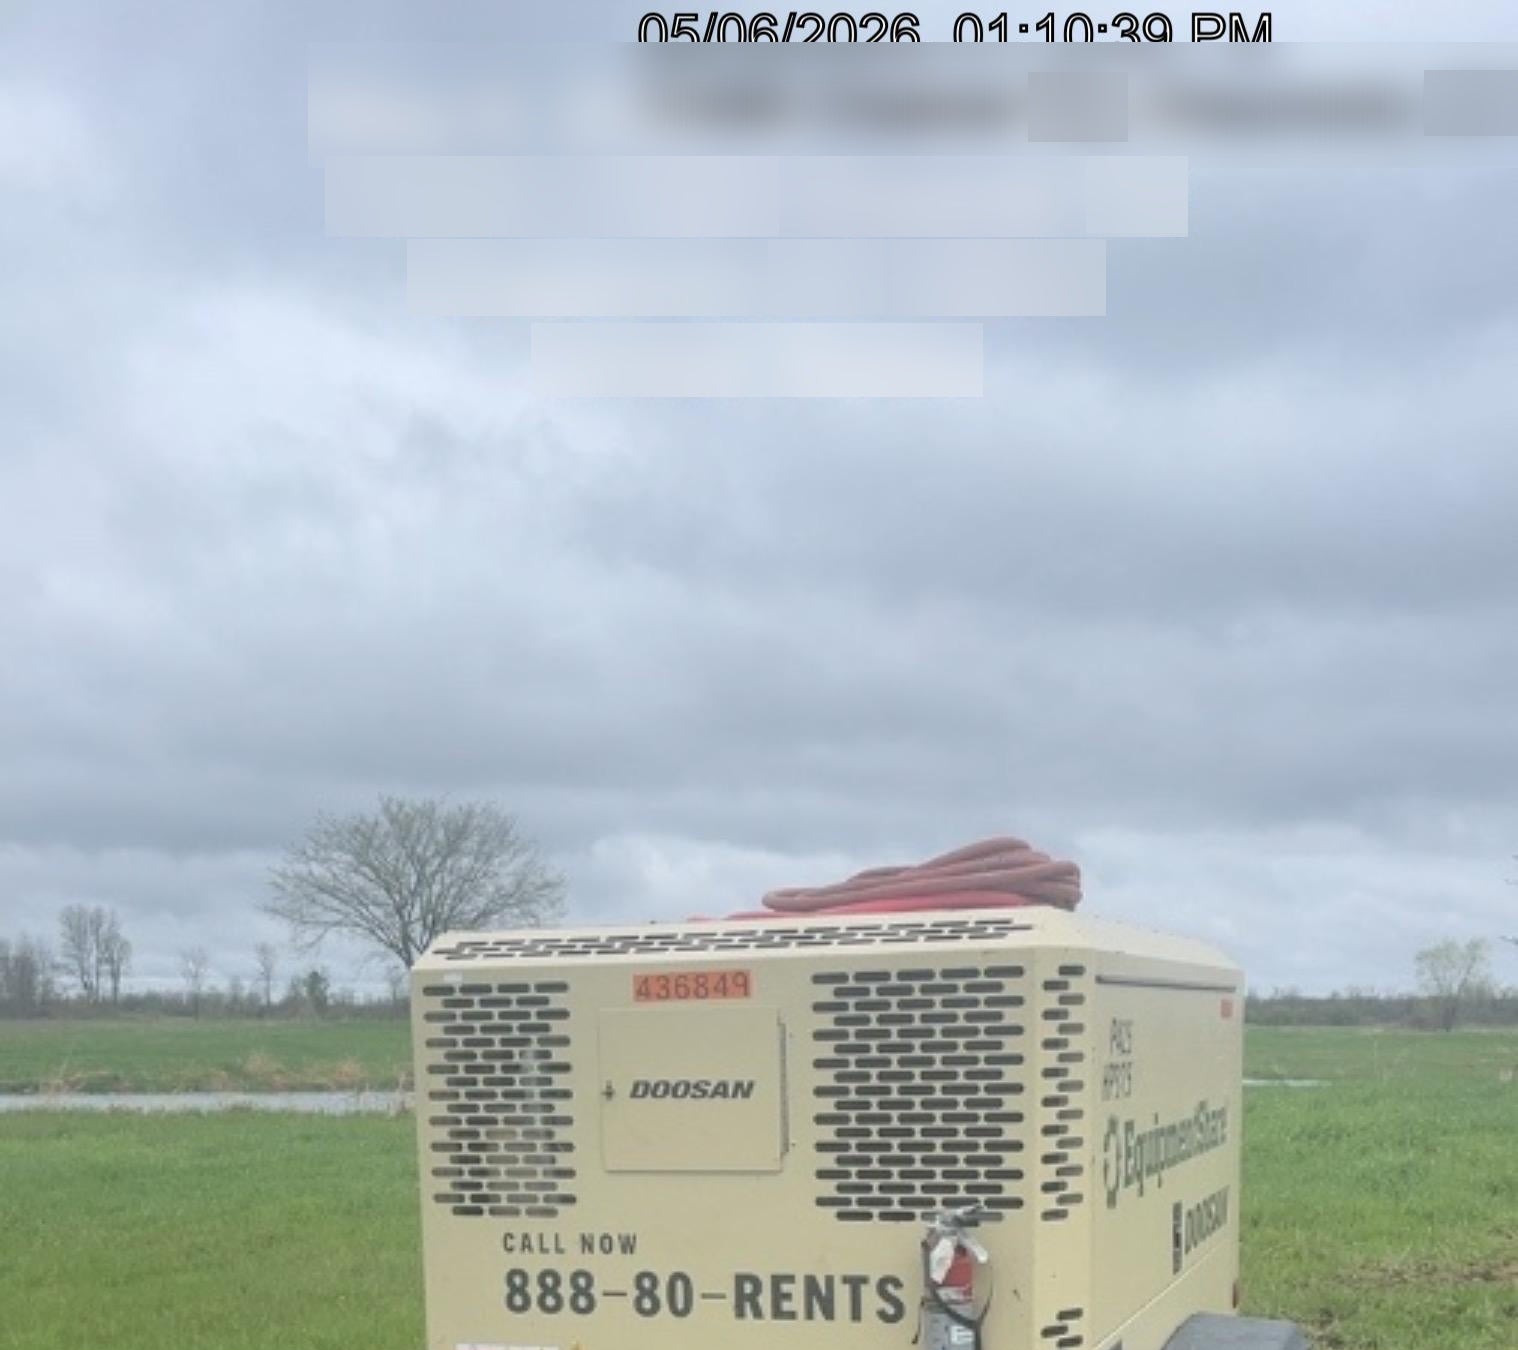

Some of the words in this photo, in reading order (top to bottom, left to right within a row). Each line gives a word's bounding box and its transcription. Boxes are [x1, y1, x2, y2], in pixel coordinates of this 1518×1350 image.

[636, 971, 750, 999] 436849
[630, 1079, 755, 1099] DOOSAN
[1124, 1100, 1227, 1198] EquipmentShare
[503, 1232, 565, 1255] CALL
[581, 1232, 637, 1255] NOW
[505, 1268, 906, 1323] 888-80-RENTS
